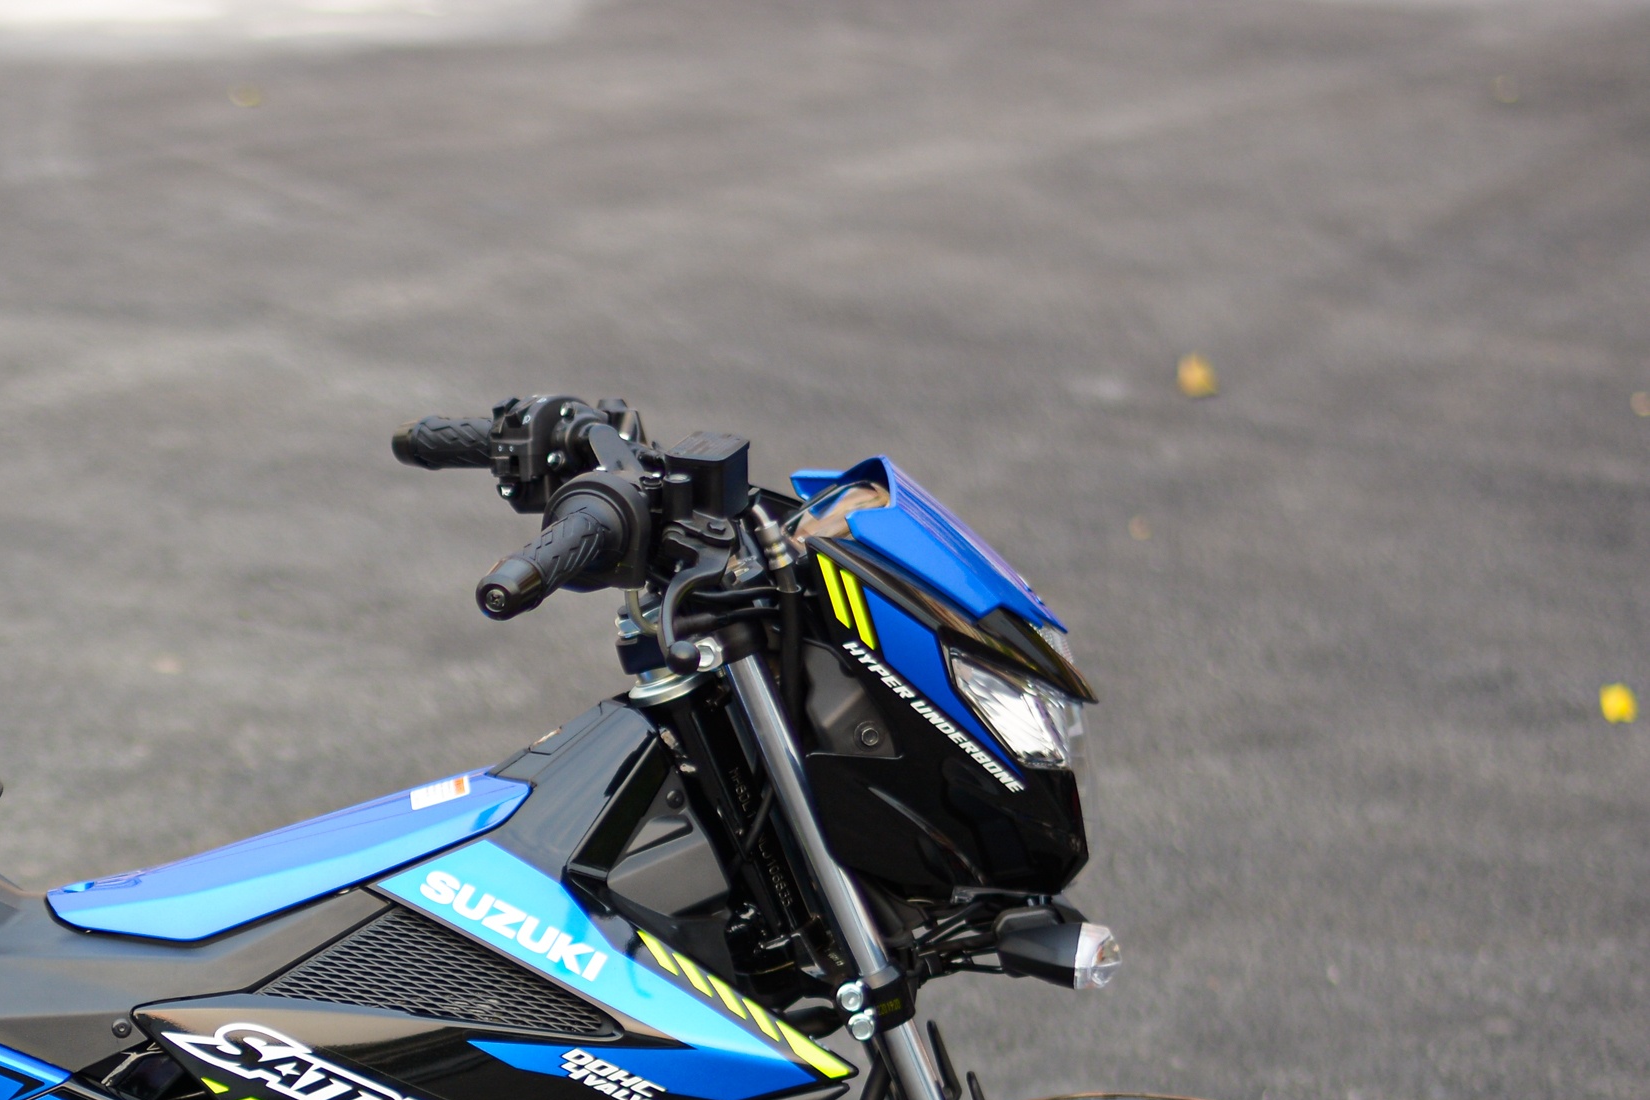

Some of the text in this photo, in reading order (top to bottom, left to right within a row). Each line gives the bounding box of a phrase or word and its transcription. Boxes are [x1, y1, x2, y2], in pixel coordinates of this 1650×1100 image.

[841, 640, 1026, 794] HYPER UNDERBONE
[418, 868, 609, 983] SUZUKI
[561, 1047, 667, 1098] DOHC
